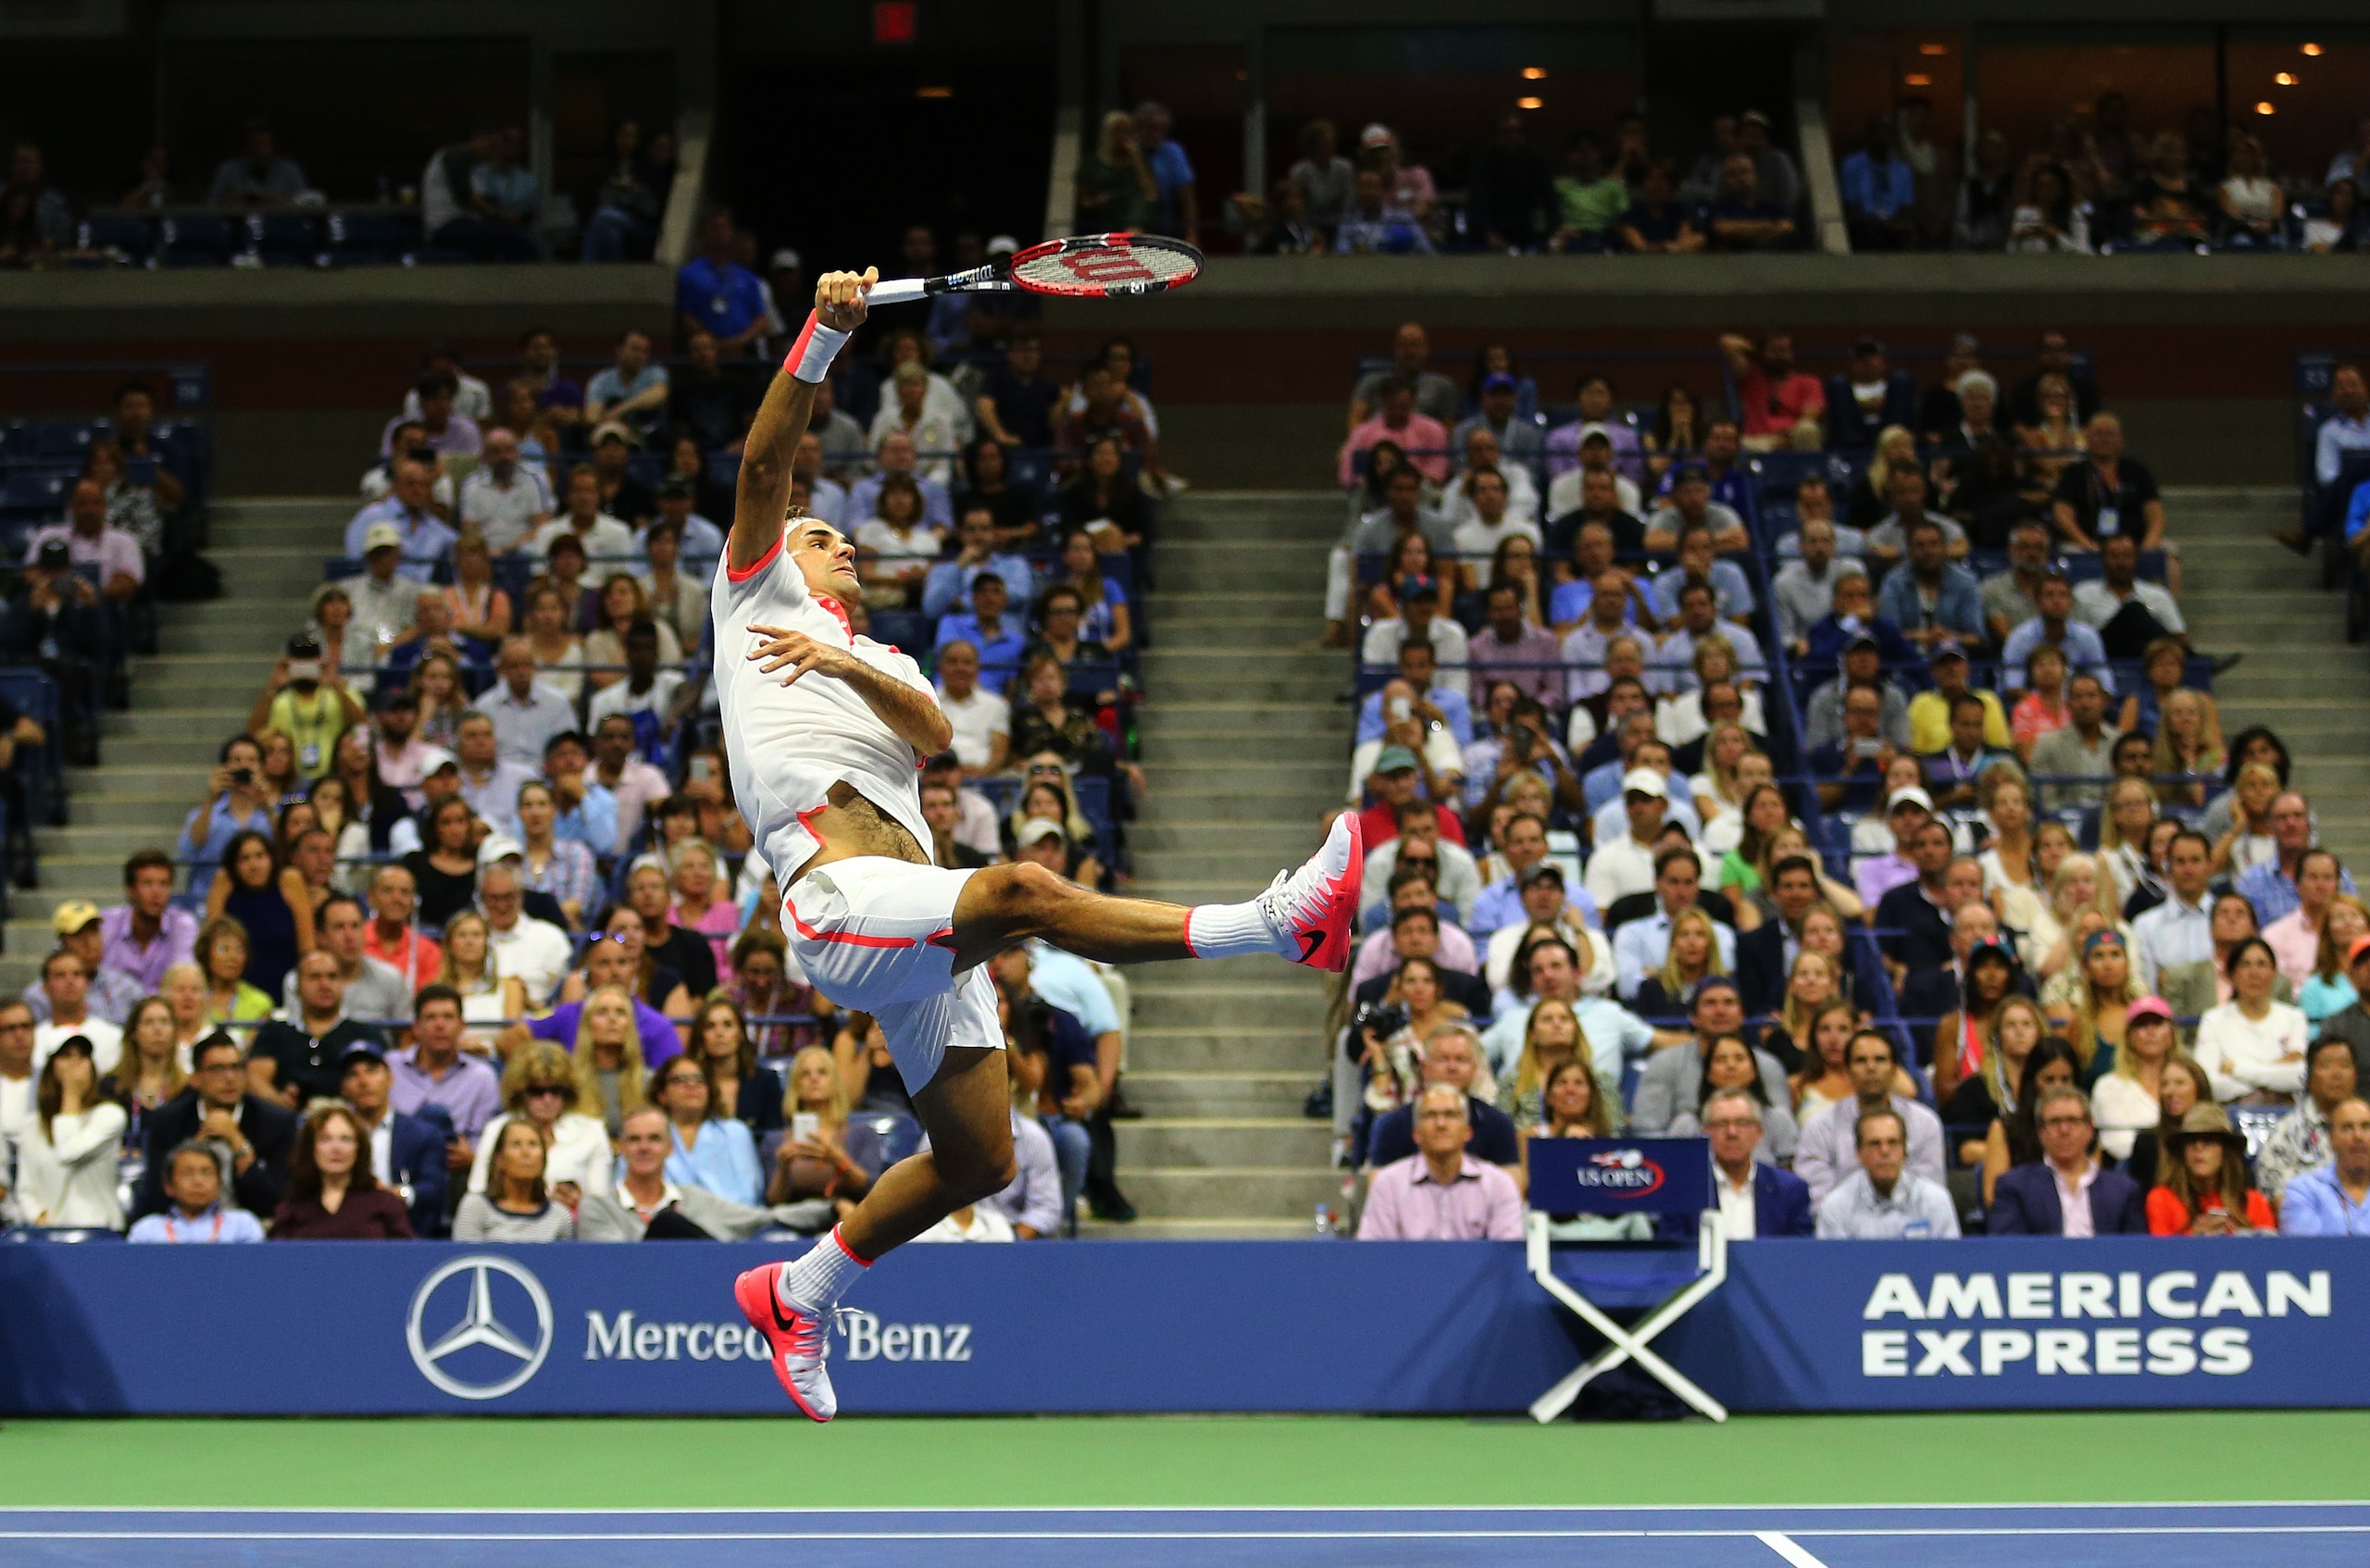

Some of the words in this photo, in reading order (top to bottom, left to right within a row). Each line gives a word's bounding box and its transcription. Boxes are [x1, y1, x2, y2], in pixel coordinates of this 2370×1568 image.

[1577, 1167, 1603, 1188] US
[1602, 1167, 1654, 1188] OPEN
[1862, 1270, 2332, 1321] AMERICAN
[1862, 1326, 2253, 1377] EXPRESS
